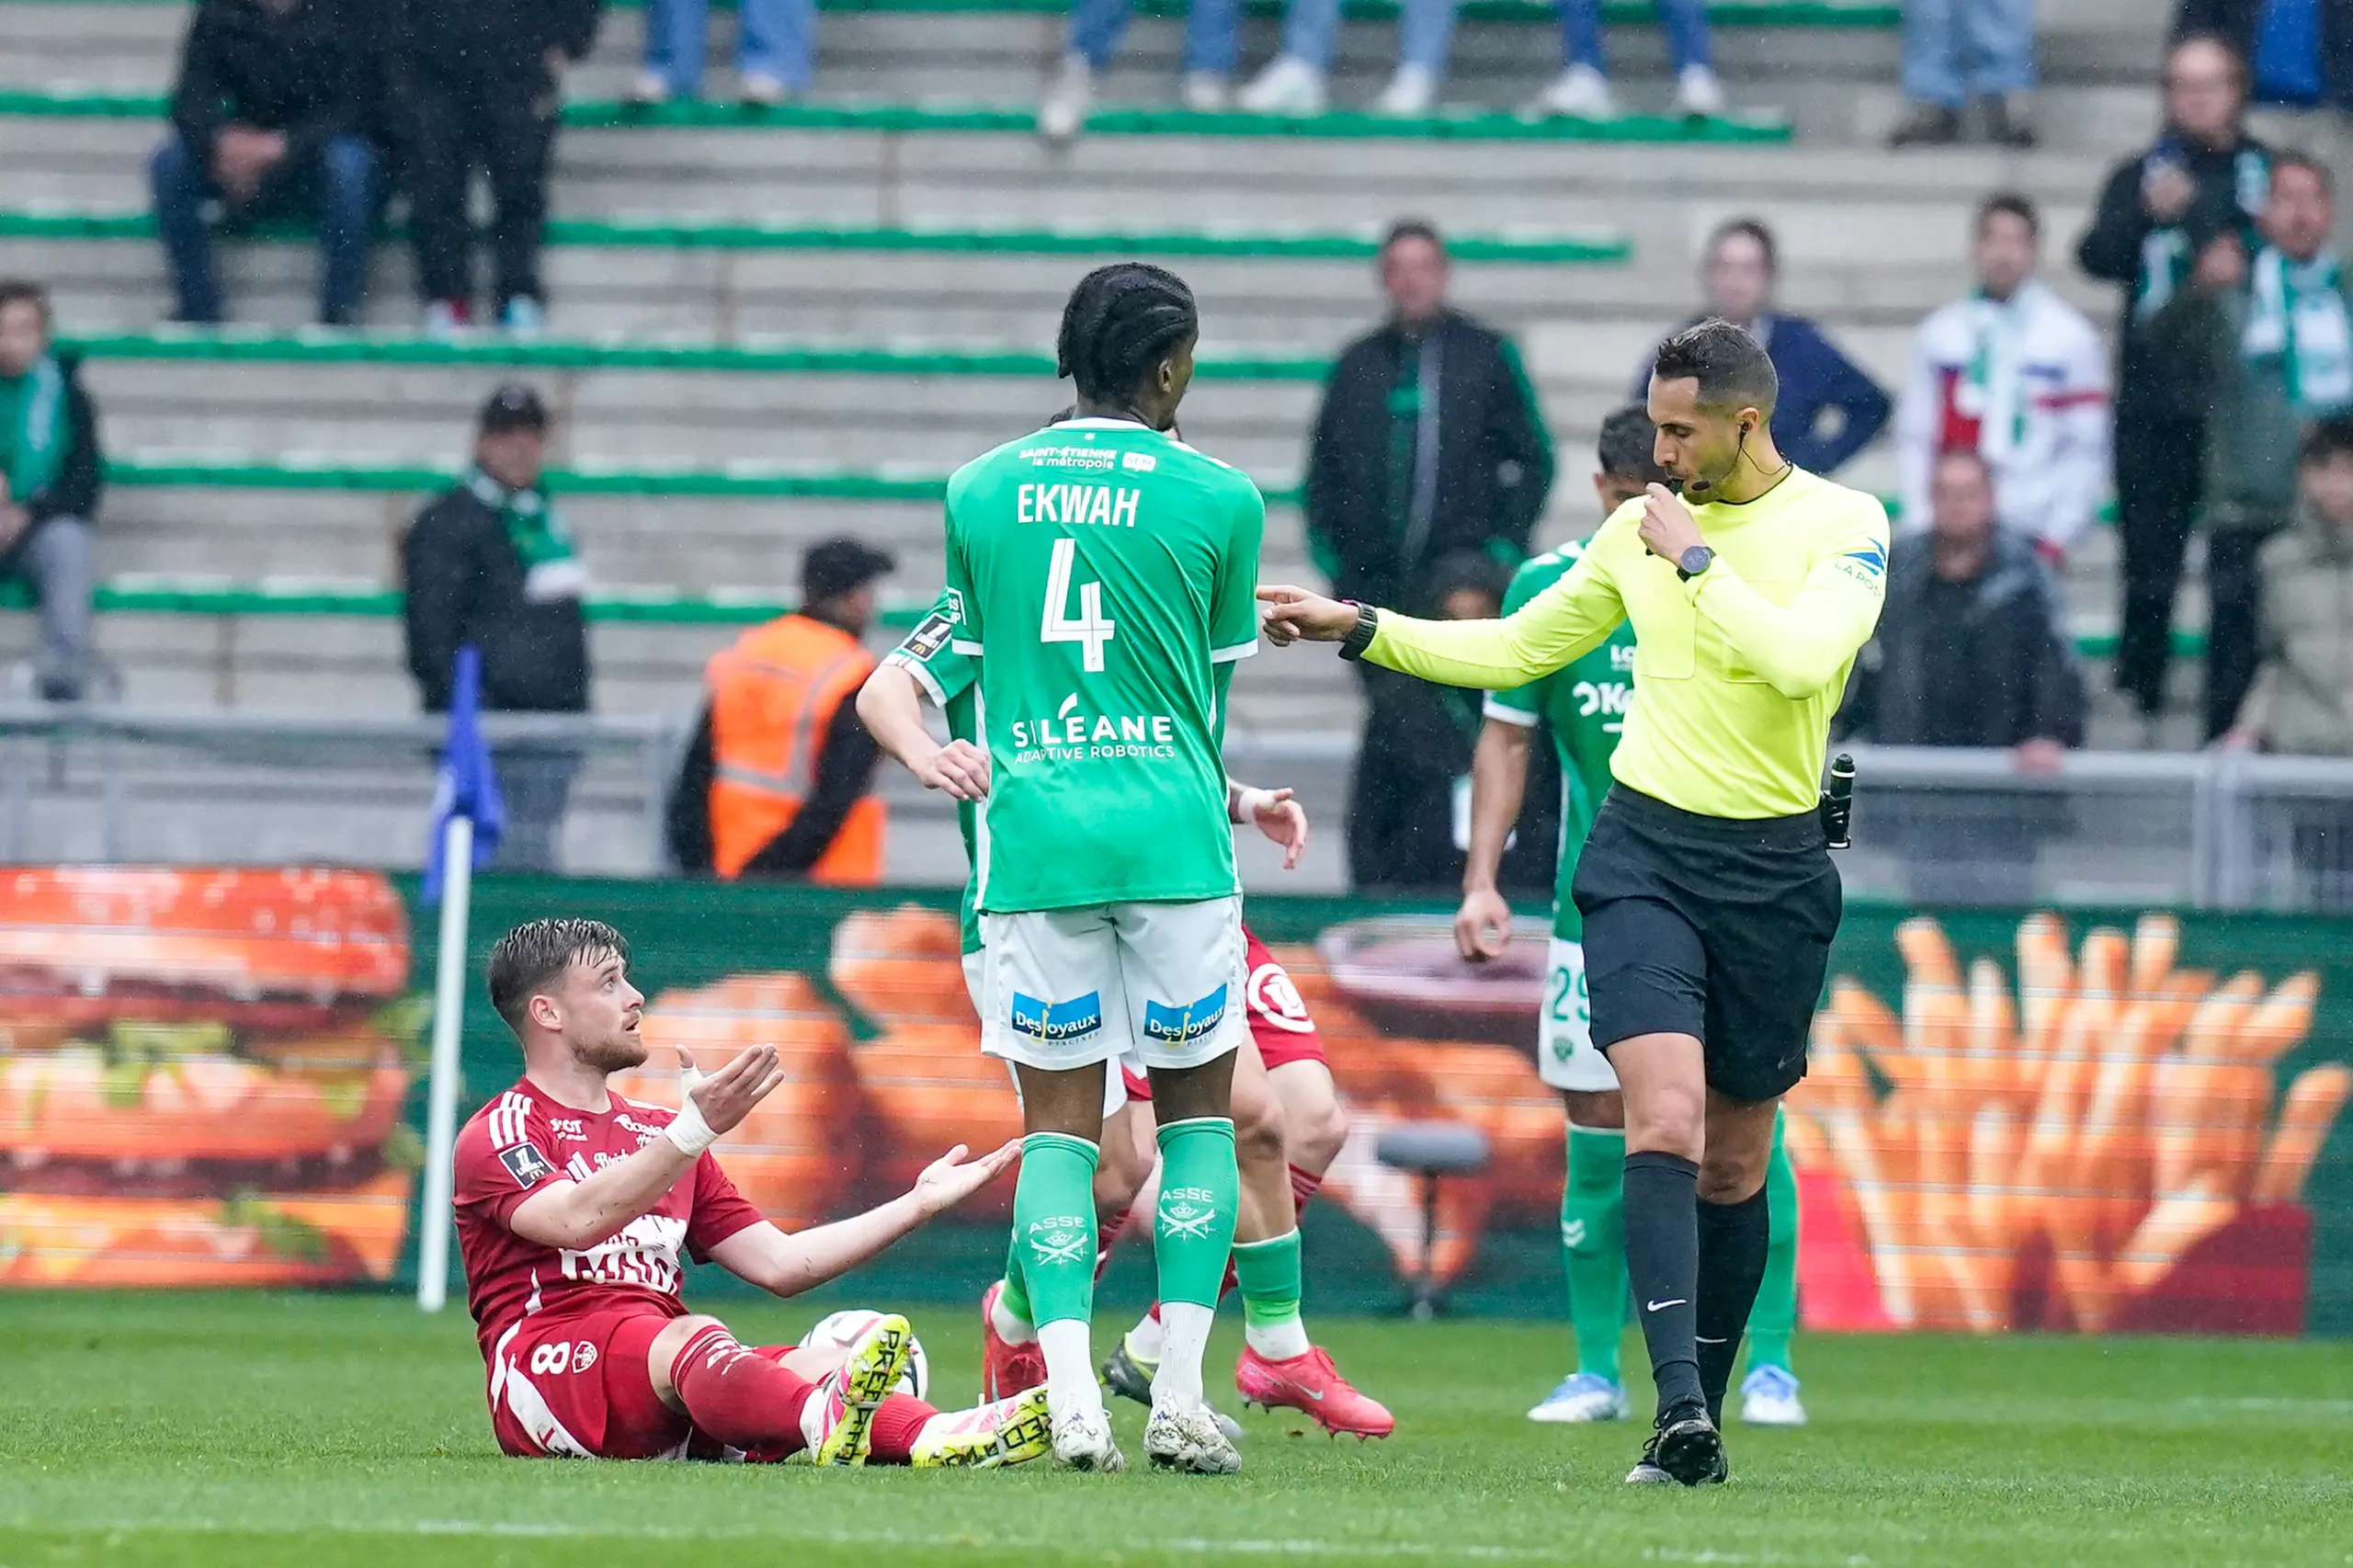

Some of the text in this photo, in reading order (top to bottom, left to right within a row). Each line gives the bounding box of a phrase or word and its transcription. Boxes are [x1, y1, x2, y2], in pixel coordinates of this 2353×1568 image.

[1017, 483, 1140, 527] EKWAH
[1040, 538, 1115, 672] 4
[1015, 744, 1176, 765] ADAPTIVE ROBOTICS
[1161, 1187, 1213, 1202] ASSE
[1029, 1216, 1086, 1234] ASSE
[530, 1342, 570, 1375] 8
